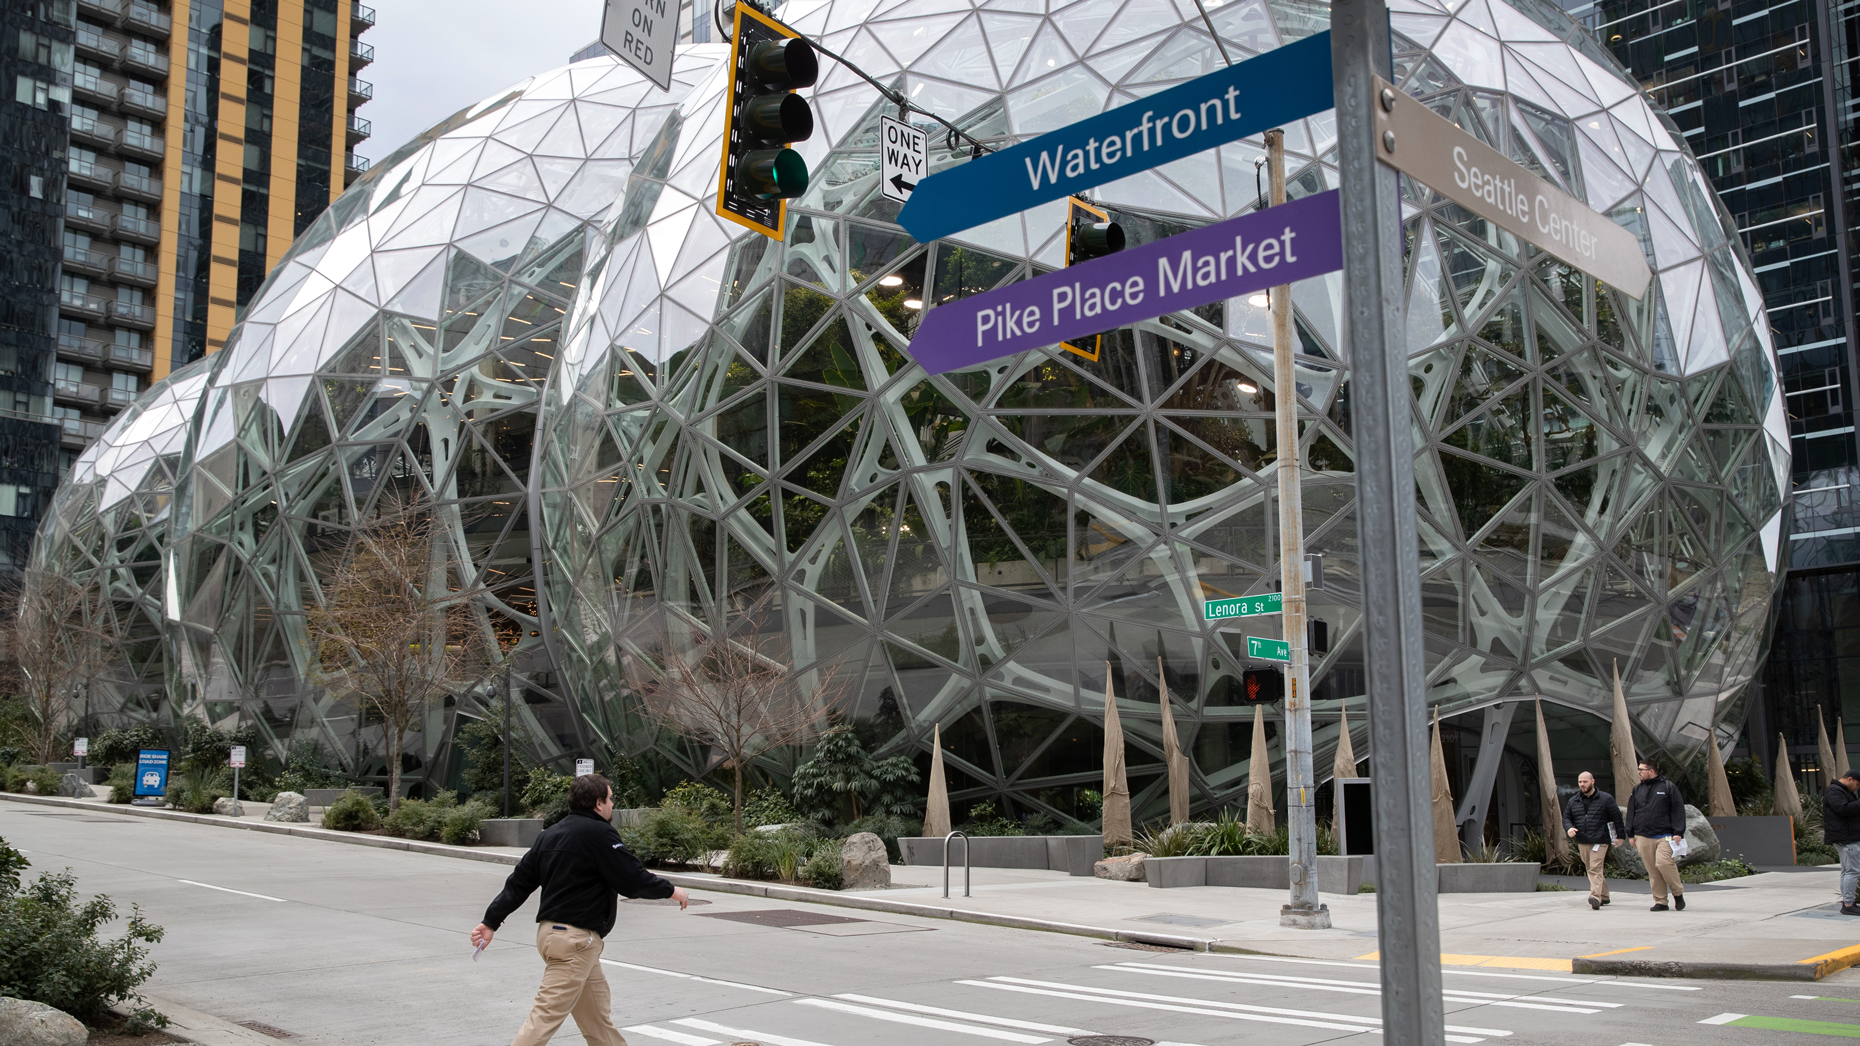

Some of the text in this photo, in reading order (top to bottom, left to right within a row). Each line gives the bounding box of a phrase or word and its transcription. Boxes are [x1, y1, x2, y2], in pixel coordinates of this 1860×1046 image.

[632, 8, 653, 38] ON
[623, 30, 653, 66] RED
[888, 125, 922, 155] ONE
[1024, 85, 1242, 191] Waterfront
[887, 146, 923, 176] WAY
[1453, 145, 1598, 261] Seattle Center
[976, 226, 1298, 347] Pike Place Market
[1209, 602, 1264, 617] Lenora St
[1268, 594, 1281, 602] 2100
[1251, 640, 1287, 657] 7th Ave
[1441, 734, 1458, 743] 2101
